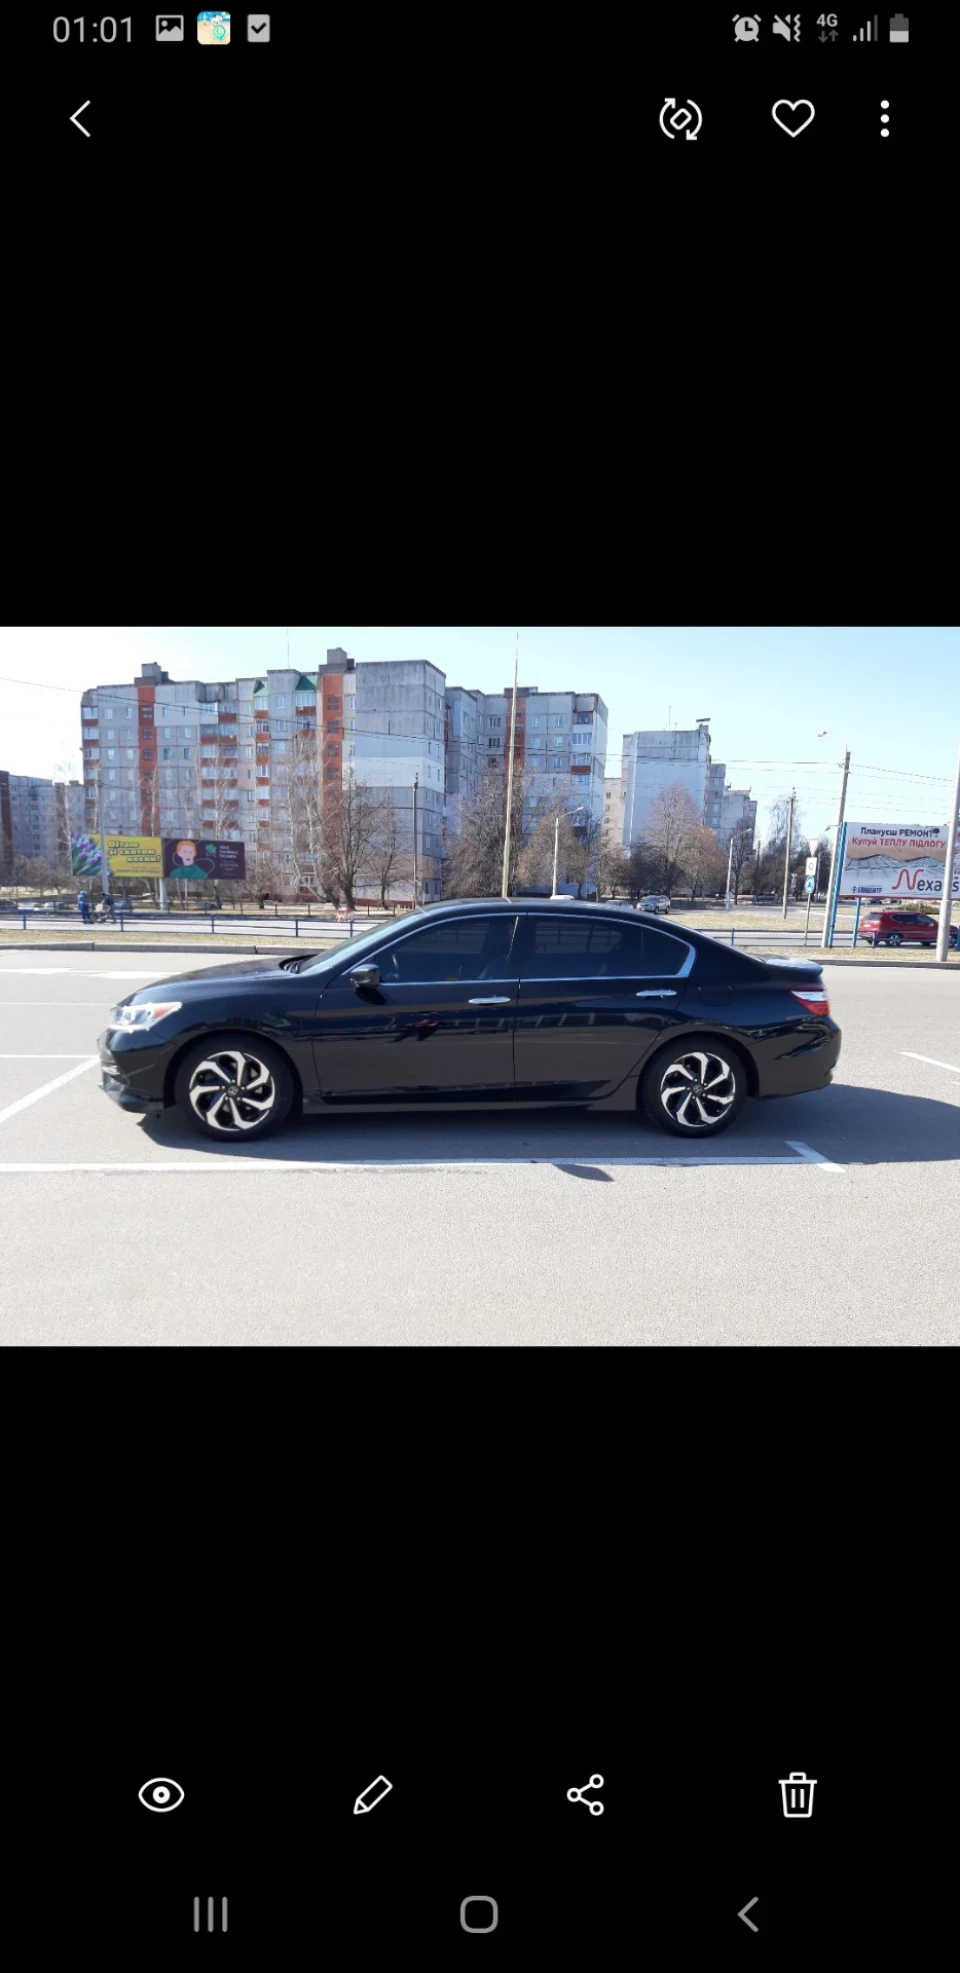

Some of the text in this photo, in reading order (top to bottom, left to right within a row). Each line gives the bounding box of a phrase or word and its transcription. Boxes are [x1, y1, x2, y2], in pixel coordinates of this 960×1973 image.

[852, 837, 946, 848] Купуй ТЕПЛУ ПІДЛОГУ
[891, 868, 959, 892] Nexas
